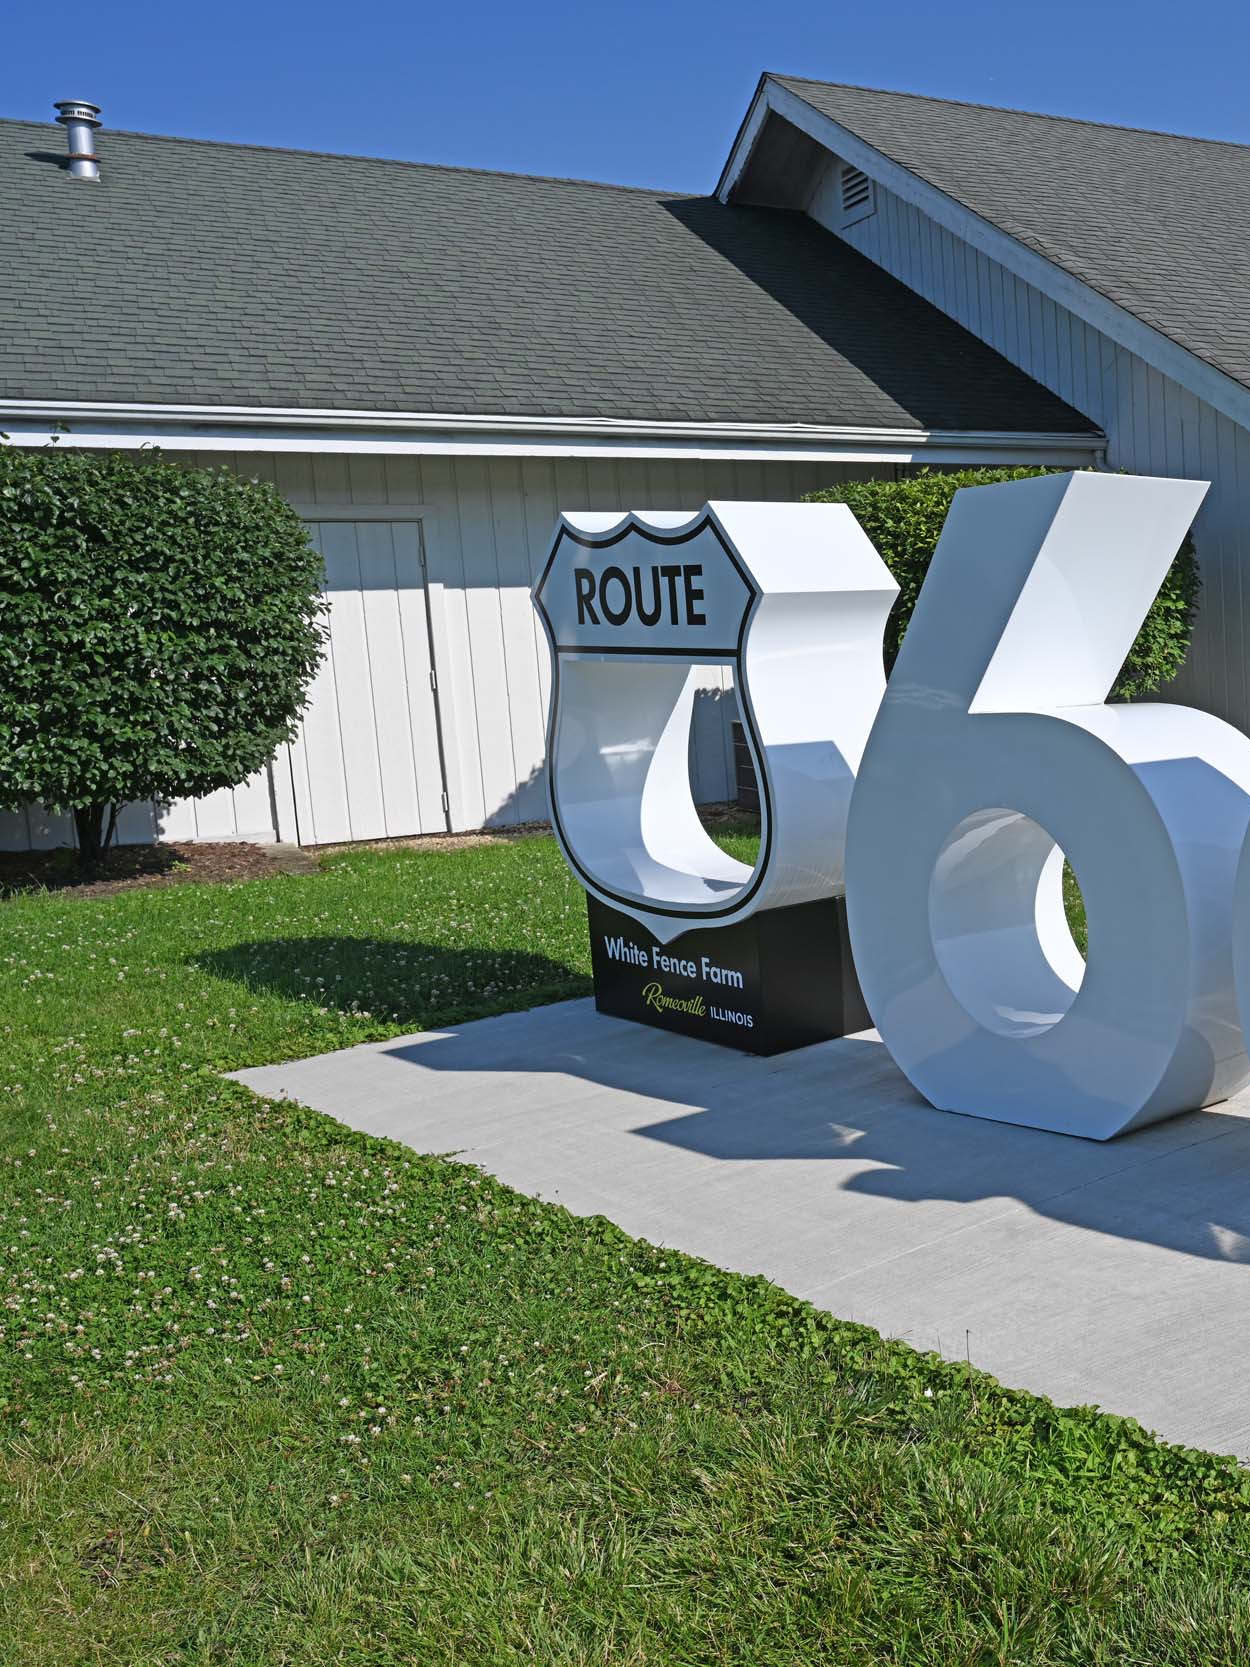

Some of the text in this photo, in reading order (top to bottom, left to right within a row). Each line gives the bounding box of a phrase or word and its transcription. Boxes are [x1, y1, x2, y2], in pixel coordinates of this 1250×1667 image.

[574, 564, 706, 627] ROUTE
[604, 935, 743, 989] White Fence Farm
[642, 982, 754, 1028] Romeoville ILLINOIS
